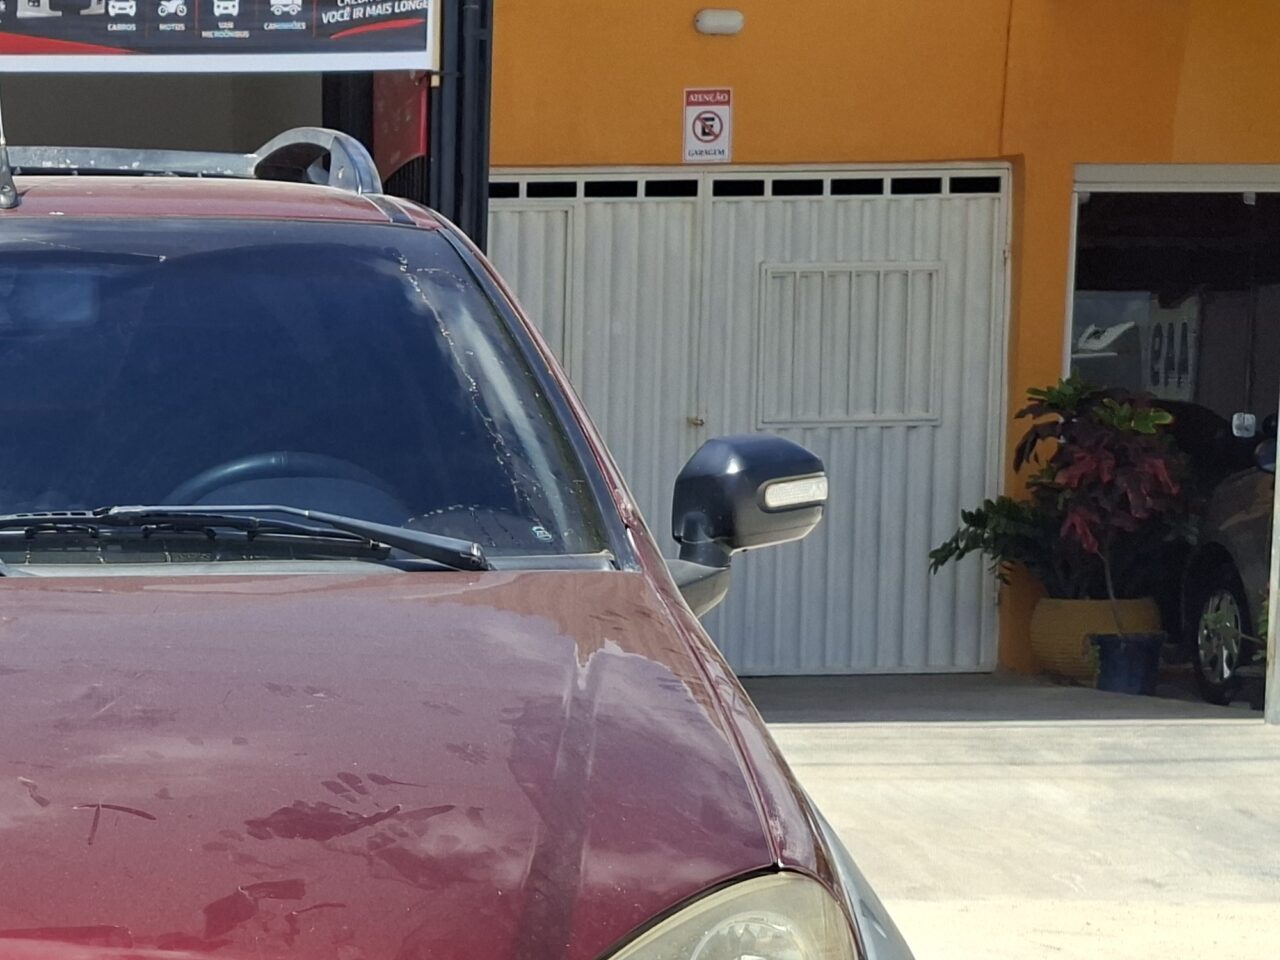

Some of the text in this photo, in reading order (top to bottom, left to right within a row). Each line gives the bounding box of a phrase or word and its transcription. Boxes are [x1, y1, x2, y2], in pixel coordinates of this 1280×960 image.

[322, 7, 350, 24] VOCÊ
[352, 8, 364, 19] IR
[366, 3, 392, 18] MAIS
[107, 23, 137, 31] CARROS
[159, 23, 186, 31] MOTOS
[688, 92, 728, 102] ATENÇÃO
